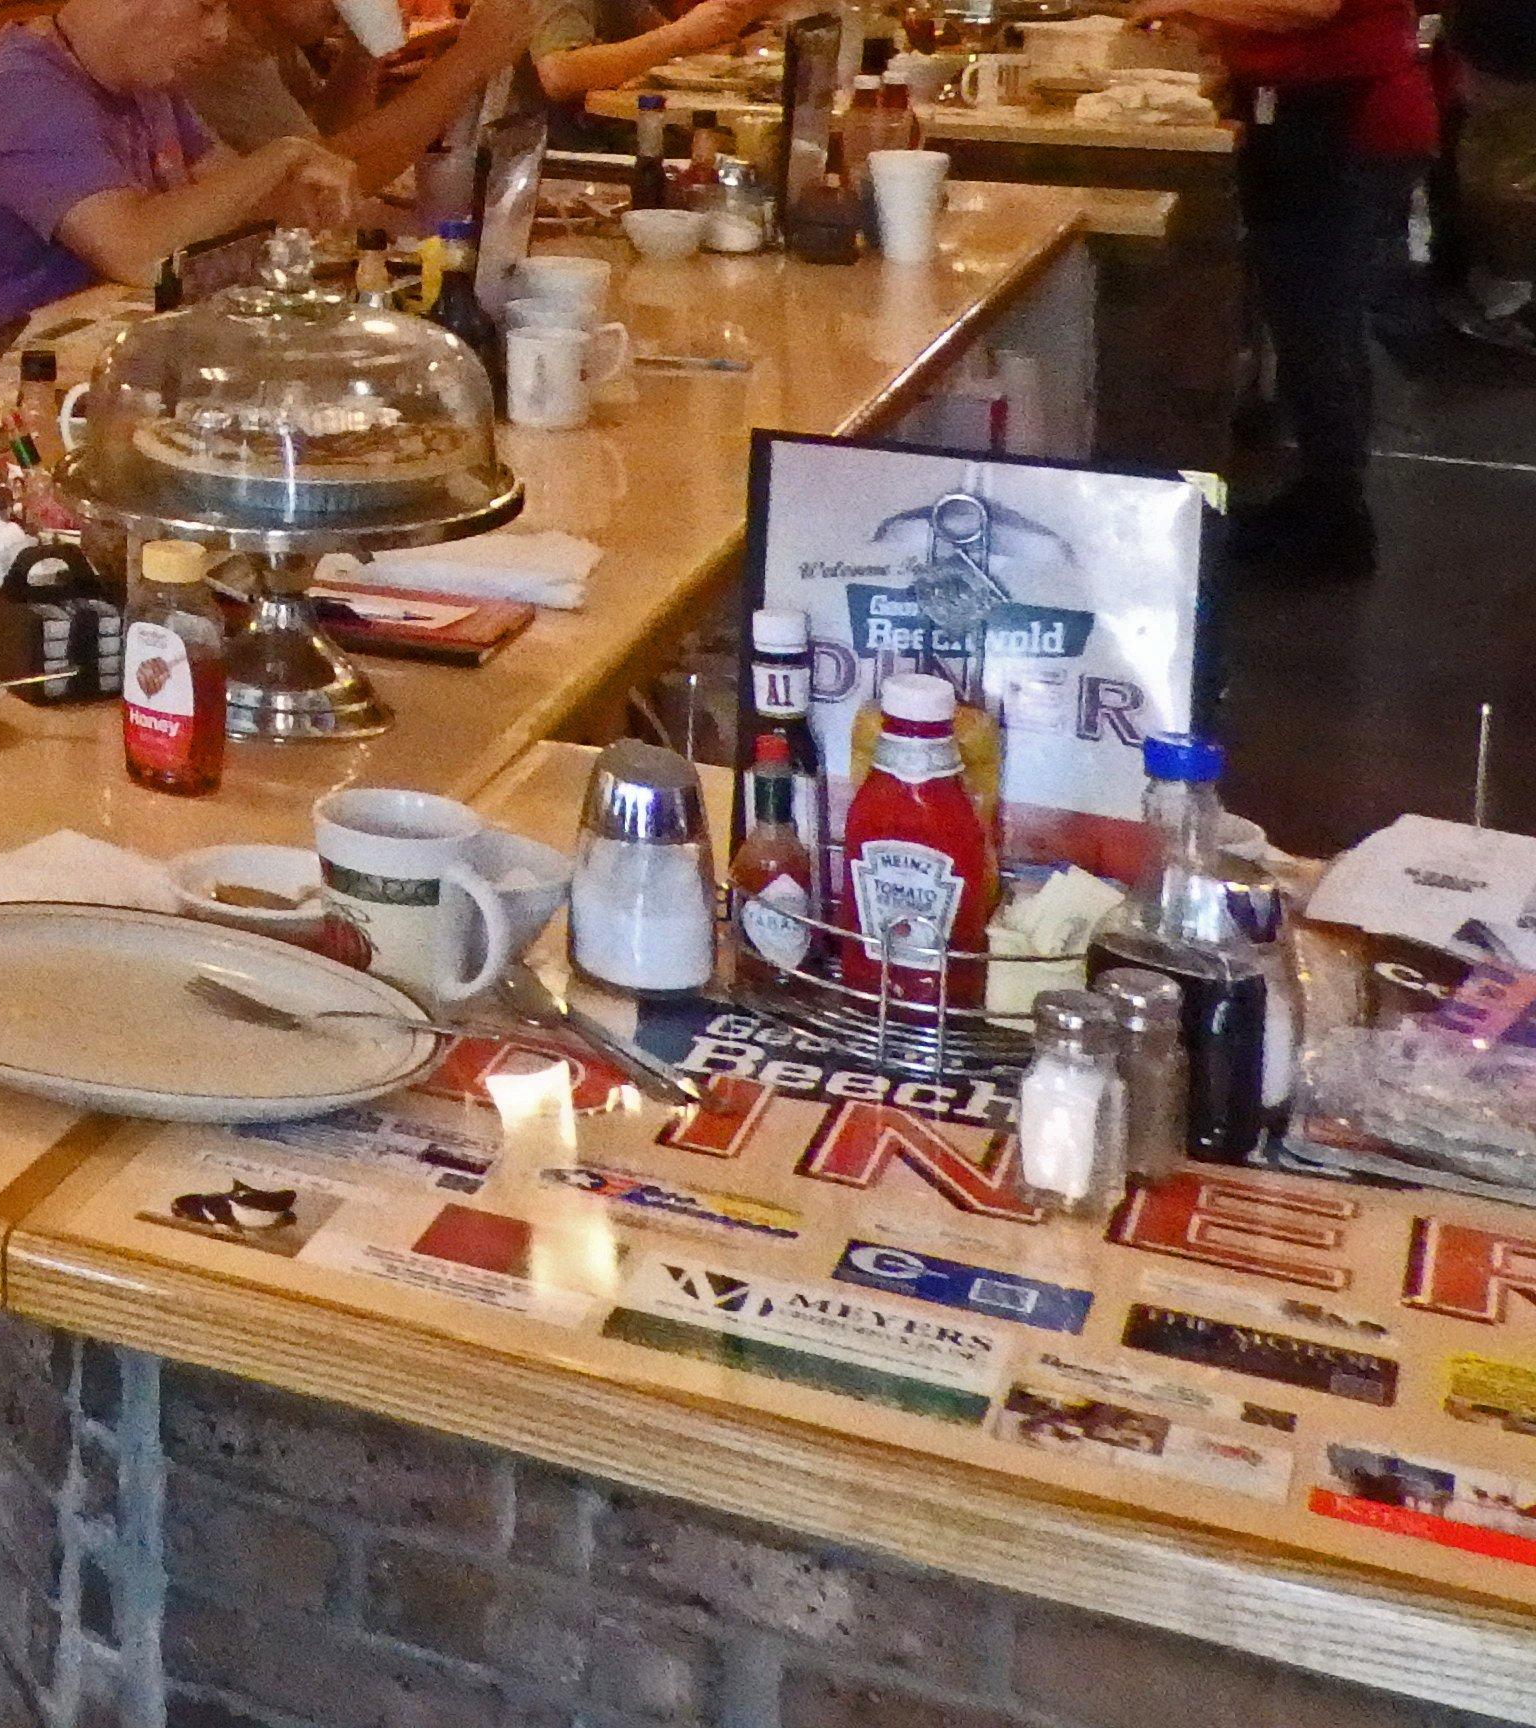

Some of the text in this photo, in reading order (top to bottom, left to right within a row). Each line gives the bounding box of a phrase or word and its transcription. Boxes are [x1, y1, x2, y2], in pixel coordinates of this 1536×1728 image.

[130, 706, 180, 737] Honey
[881, 854, 932, 875] HEINZ
[874, 878, 938, 904] TOMATO
[787, 1292, 993, 1353] MEYERS
